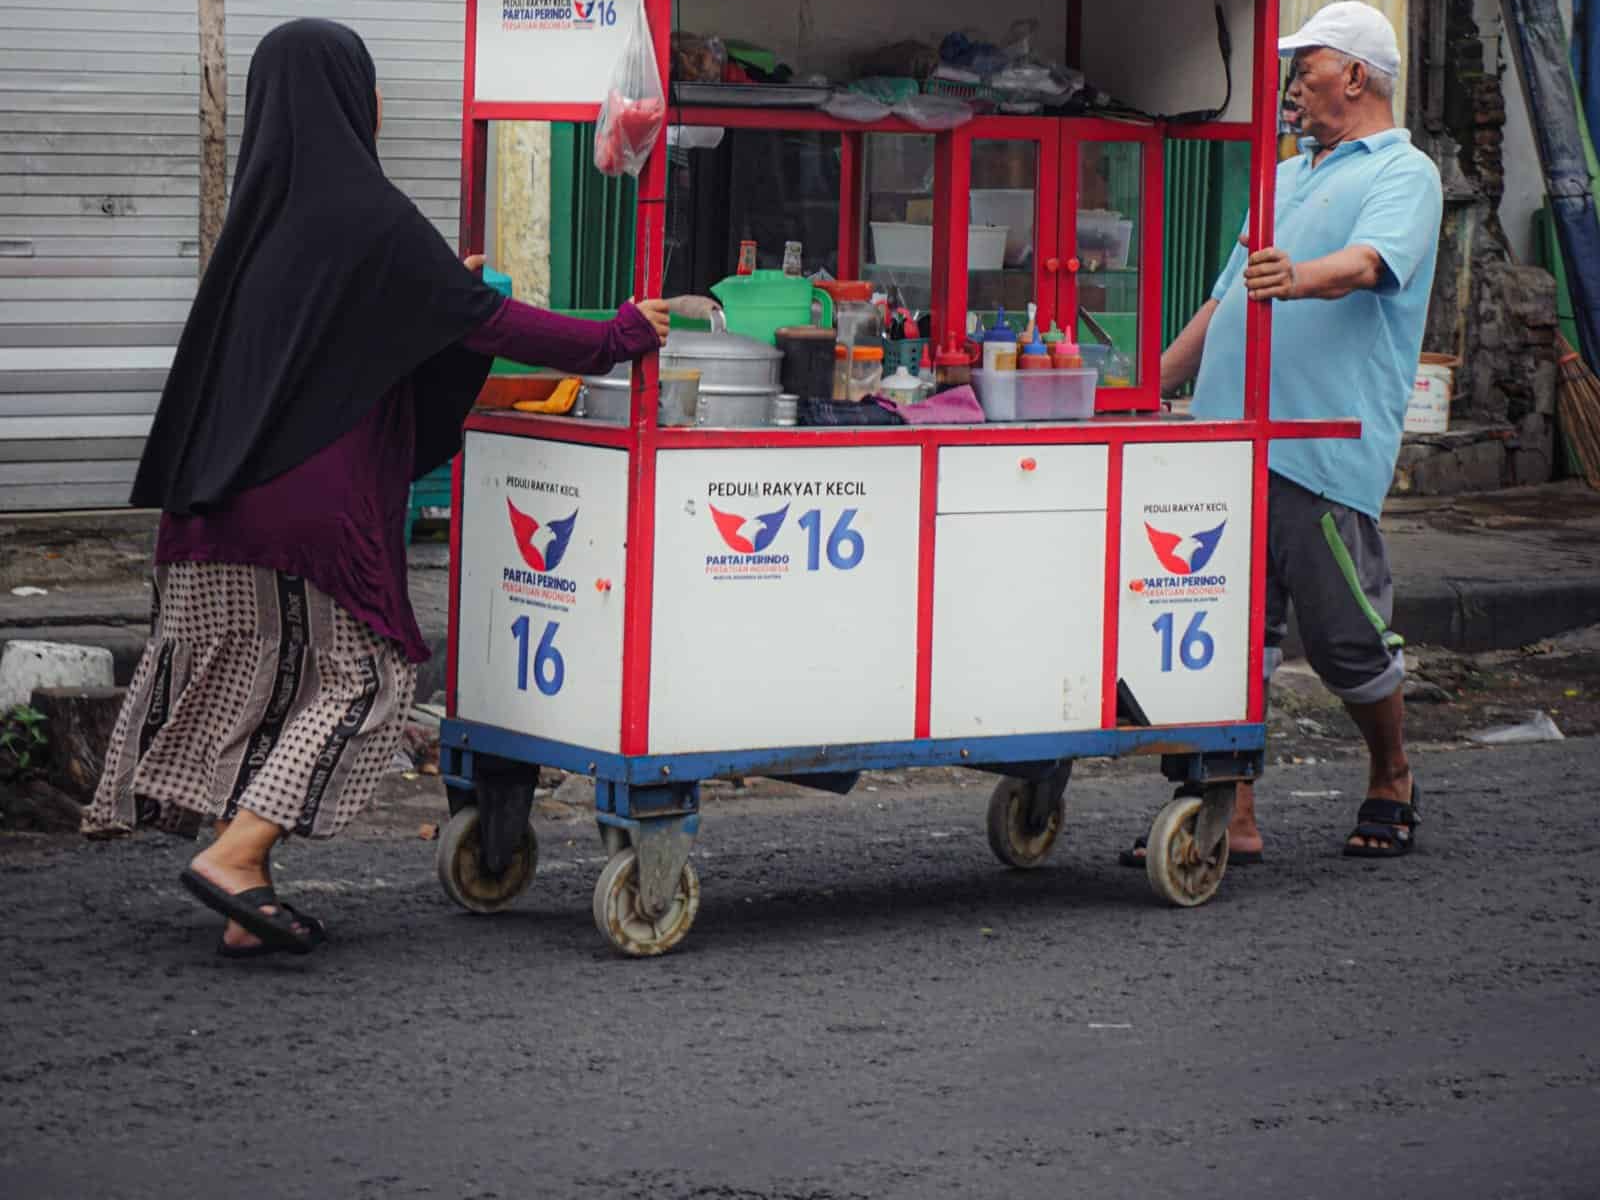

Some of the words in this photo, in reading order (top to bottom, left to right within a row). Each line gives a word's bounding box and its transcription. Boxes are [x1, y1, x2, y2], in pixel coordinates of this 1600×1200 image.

[503, 9, 534, 19] PARTAI
[535, 8, 571, 19] PERINDO
[598, 0, 616, 26] 16
[506, 475, 530, 489] PEDULI
[531, 479, 559, 493] RAKYAT
[560, 484, 580, 498] KECIL
[762, 482, 822, 497] RAKYAT
[826, 482, 867, 496] KECIL
[1143, 504, 1171, 513] PEDULI
[1172, 503, 1204, 512] RAKYAT
[1206, 502, 1228, 512] KECIL
[798, 509, 865, 571] 16
[706, 555, 744, 565] PARTAI
[745, 554, 790, 565] PERINDO
[503, 567, 537, 586] PARTAI
[537, 574, 577, 593] PERINDO
[1182, 575, 1226, 586] PERINDO
[1152, 611, 1214, 672] 16
[511, 615, 565, 697] 16
